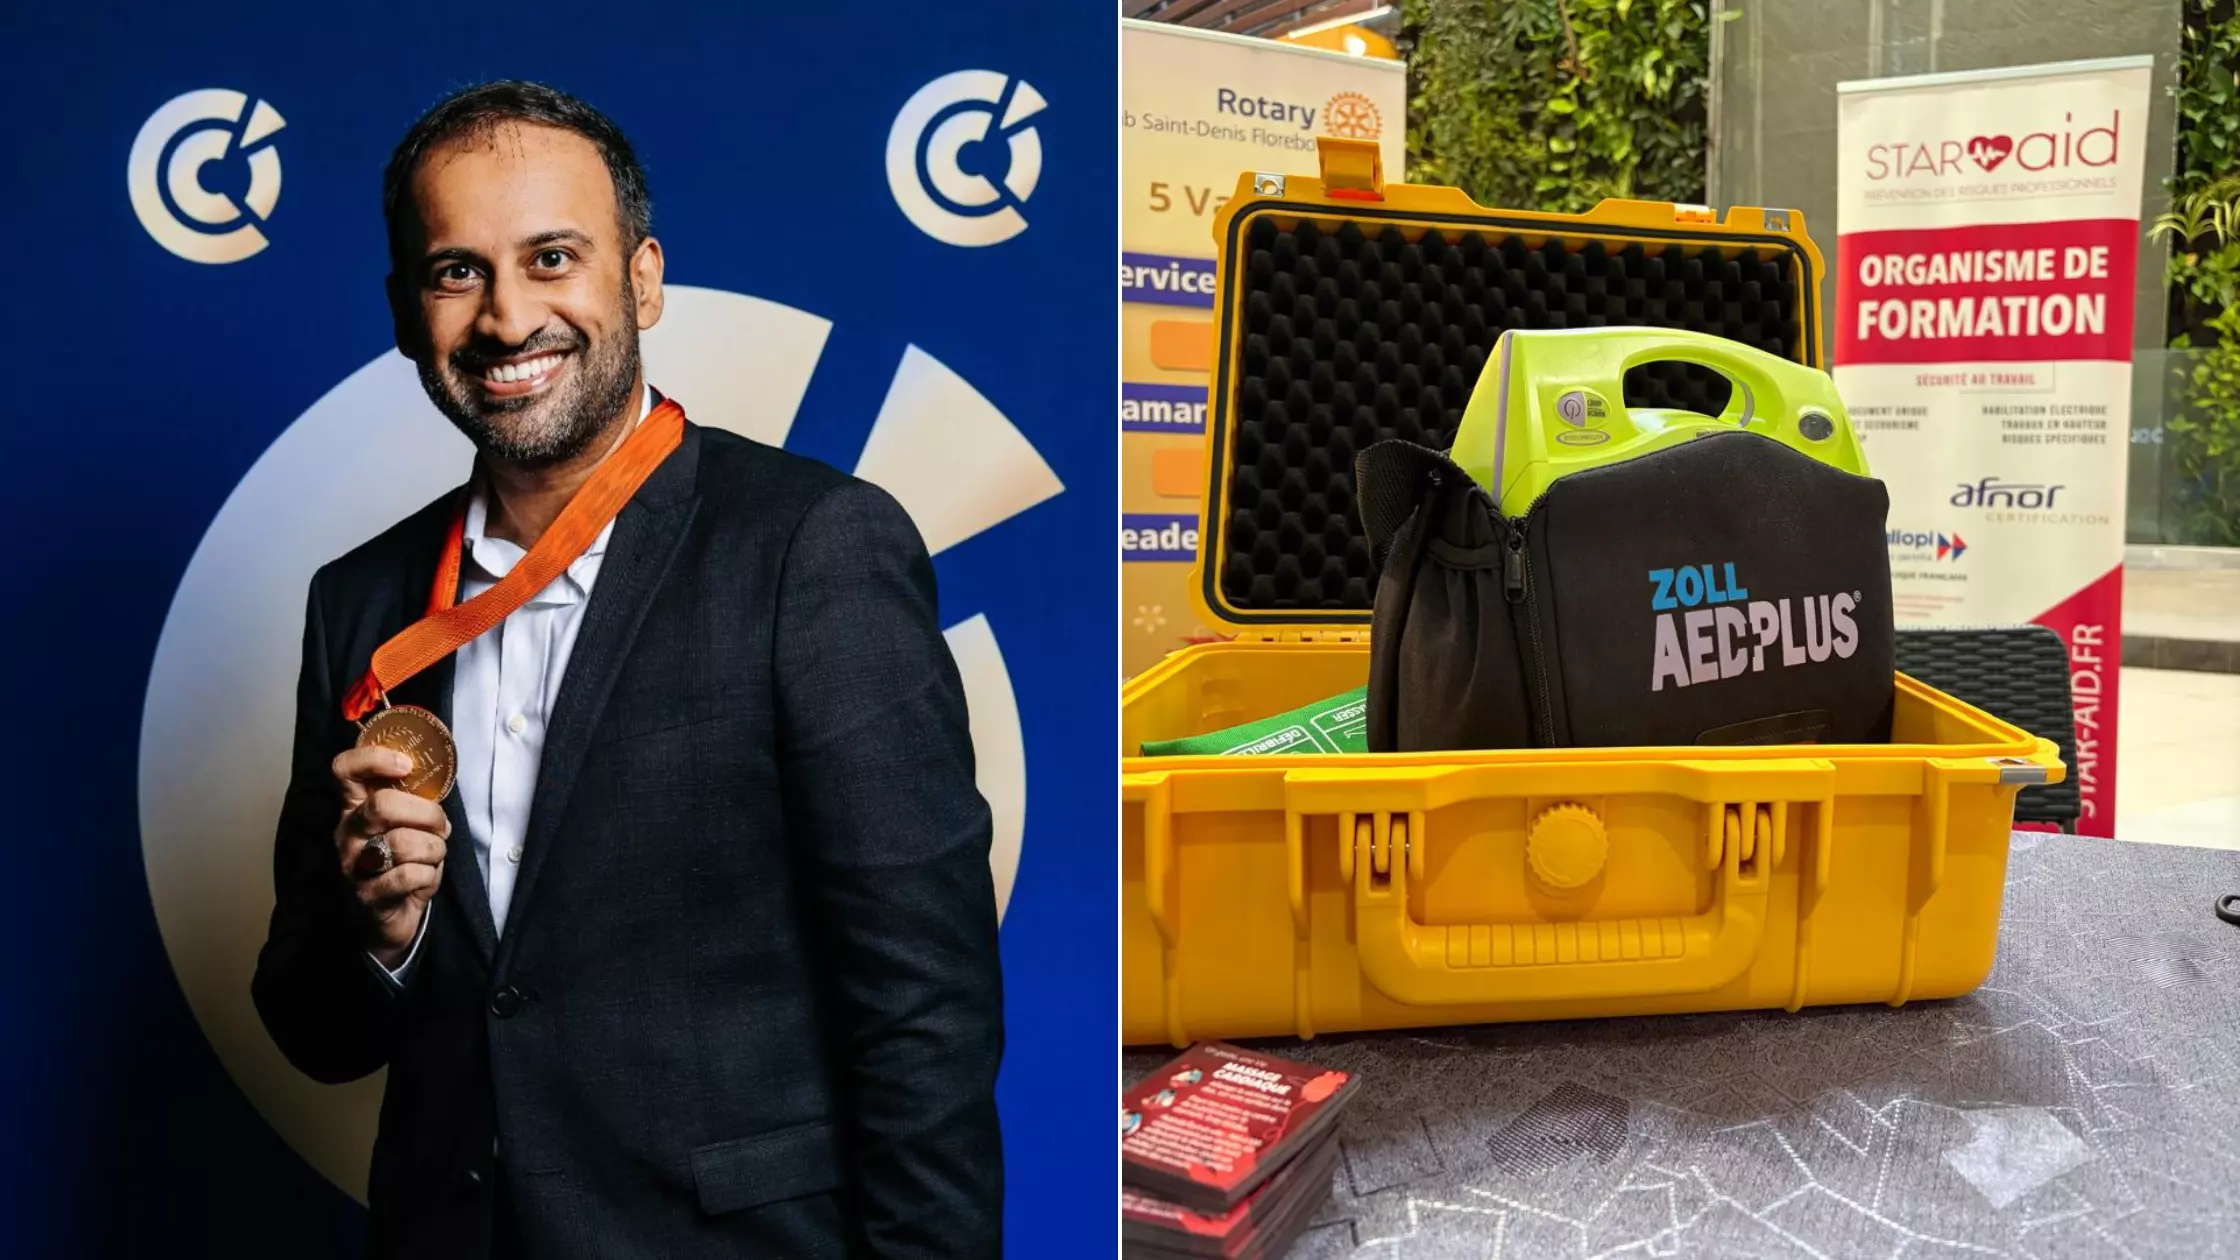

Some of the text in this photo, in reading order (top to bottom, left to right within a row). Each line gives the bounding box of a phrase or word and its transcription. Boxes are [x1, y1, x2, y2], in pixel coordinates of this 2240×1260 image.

[1218, 88, 1316, 131] Rotary
[1143, 113, 1247, 143] Saint-Denis
[1866, 109, 2119, 181] STAR aid
[1149, 181, 1171, 213] 5
[1859, 246, 2109, 288] ORGANISME DE
[1857, 293, 2106, 341] FORMATION
[1990, 373, 2037, 386] TRAVAIL
[1950, 476, 2066, 509] afnor
[1985, 511, 2110, 526] CERTIFICATION
[1649, 561, 1748, 611] ZOLL
[1212, 1069, 1292, 1095] CARDIAQUE
[1221, 1062, 1283, 1082] MASSAGE
